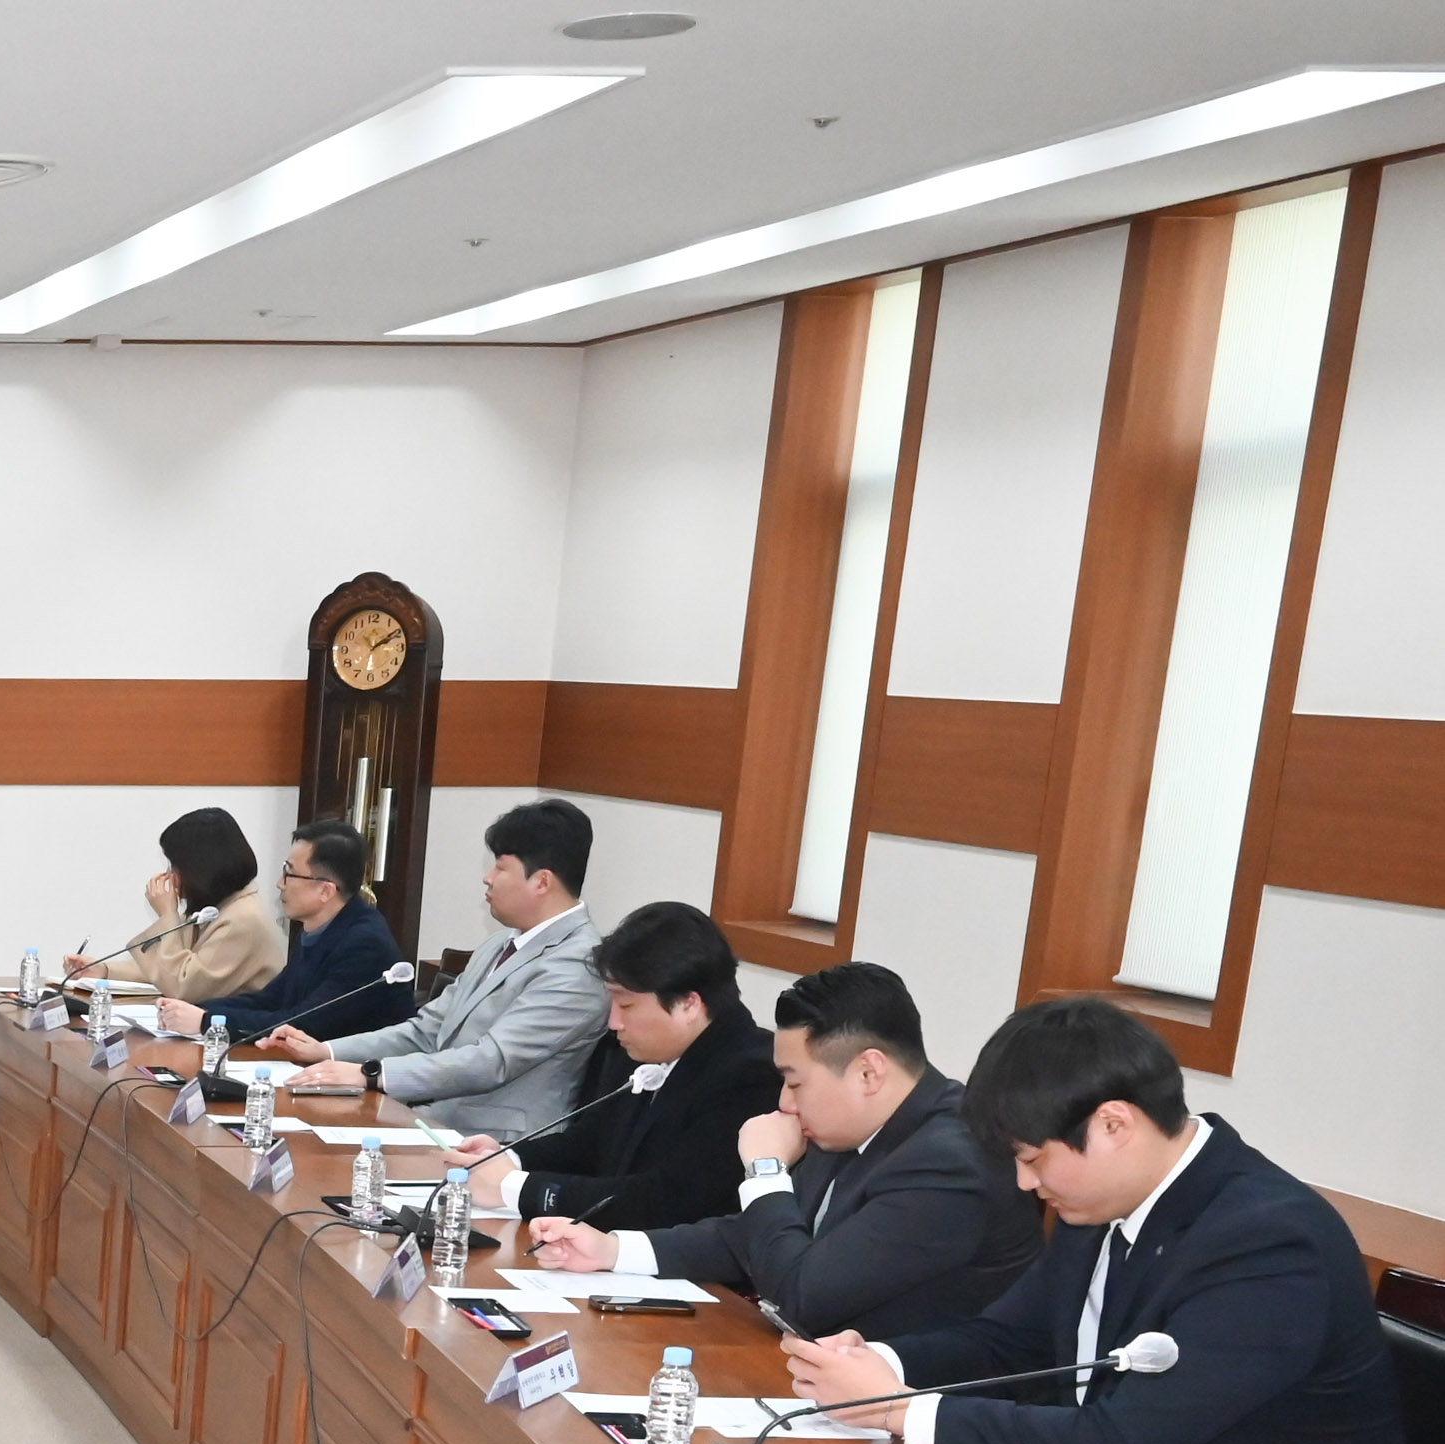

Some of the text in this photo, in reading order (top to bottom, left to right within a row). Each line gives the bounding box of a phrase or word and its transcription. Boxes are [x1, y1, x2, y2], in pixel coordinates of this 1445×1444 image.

[368, 613, 380, 624] 12
[354, 619, 364, 629] 11
[345, 631, 355, 640] 10
